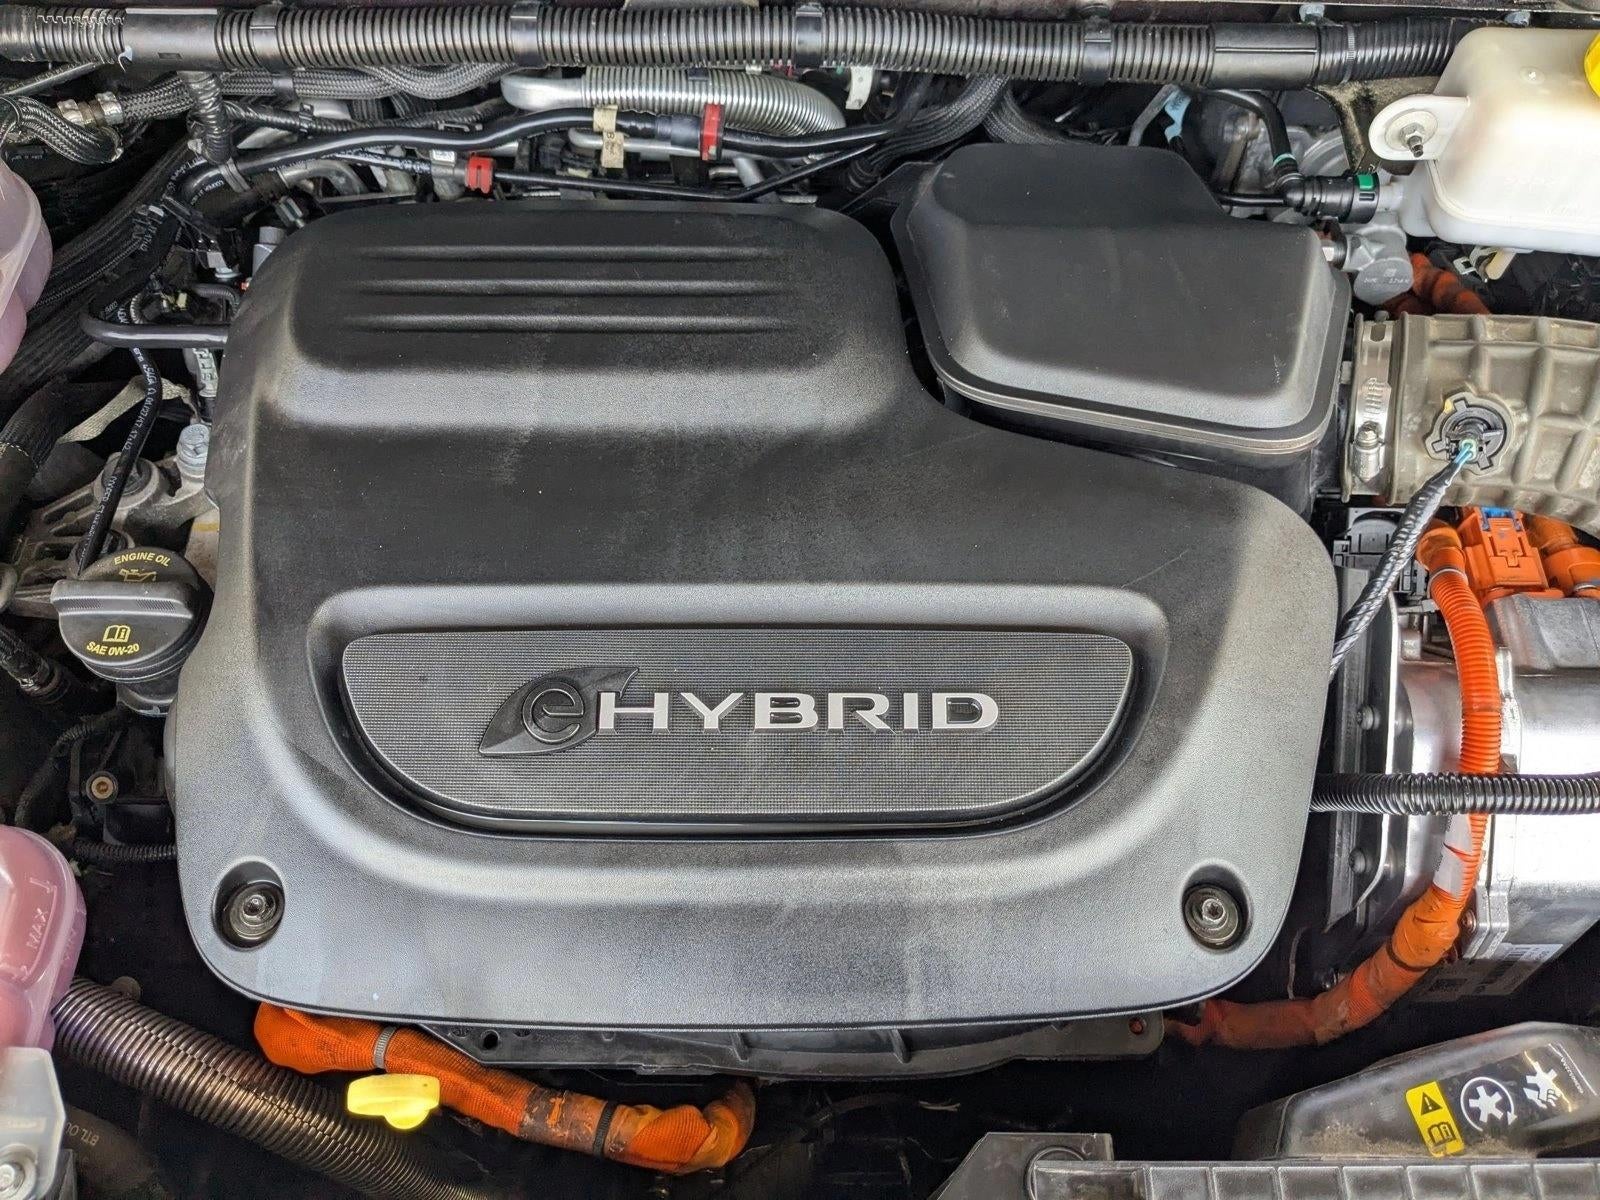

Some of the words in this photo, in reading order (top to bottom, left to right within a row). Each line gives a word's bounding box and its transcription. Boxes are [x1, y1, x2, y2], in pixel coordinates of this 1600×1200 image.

[114, 552, 155, 565] ENGINE
[156, 556, 171, 567] OIL
[86, 642, 107, 655] SAE
[108, 643, 140, 656] 0W-20
[25, 907, 48, 950] MAX
